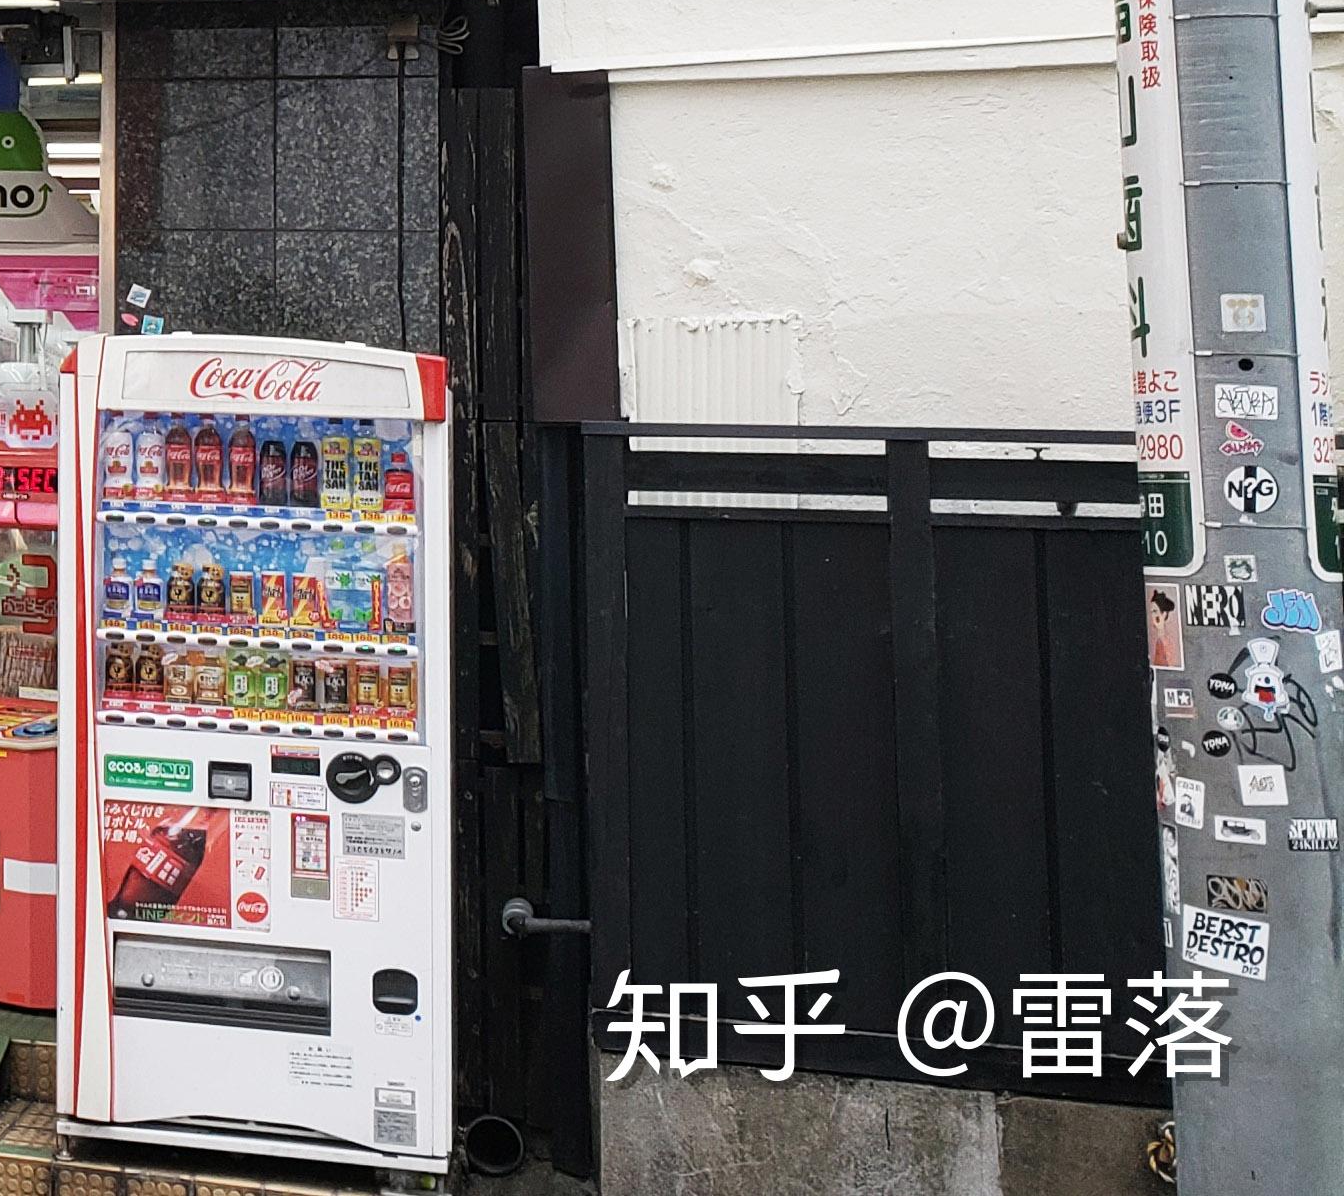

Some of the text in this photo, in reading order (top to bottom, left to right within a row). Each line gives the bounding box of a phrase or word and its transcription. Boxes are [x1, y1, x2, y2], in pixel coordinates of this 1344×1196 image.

[190, 356, 329, 402] Coca-Cola
[1193, 912, 1262, 943] BERST
[1186, 931, 1265, 965] DESTRO
